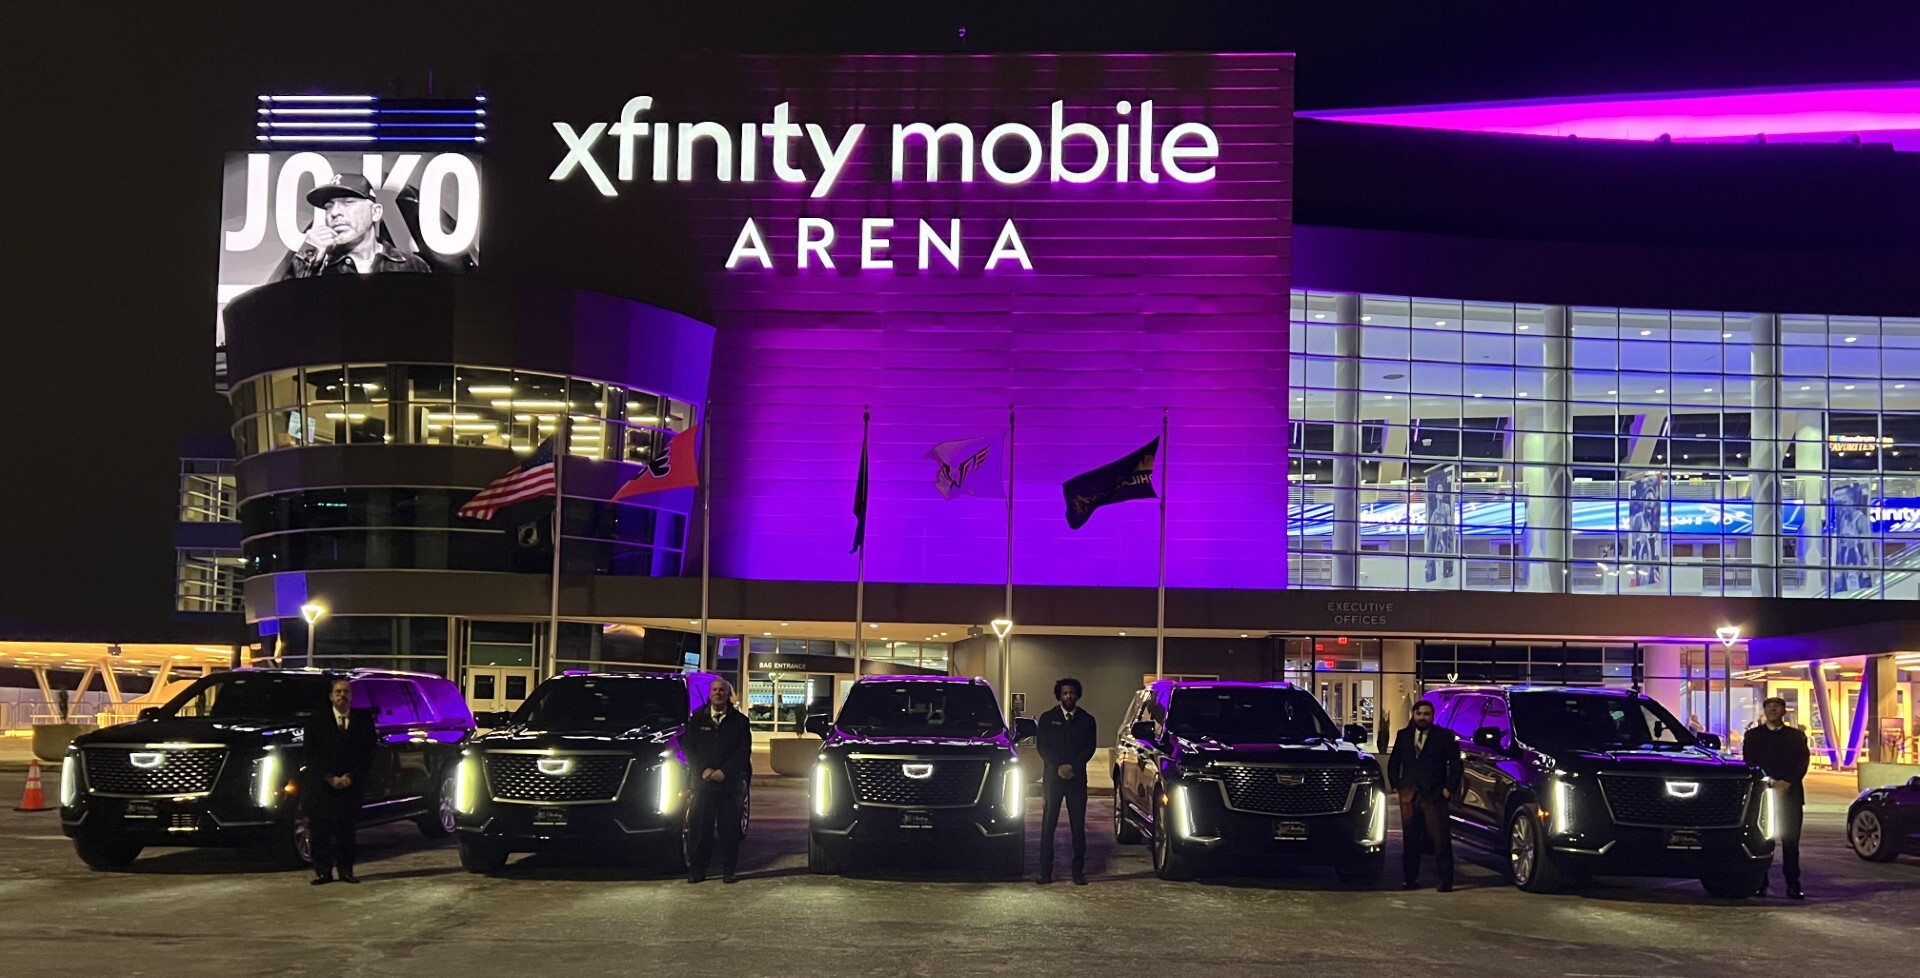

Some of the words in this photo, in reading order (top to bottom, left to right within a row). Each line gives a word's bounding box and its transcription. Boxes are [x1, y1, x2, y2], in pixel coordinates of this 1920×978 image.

[550, 96, 867, 198] xfinity
[891, 99, 1220, 184] mobile
[225, 152, 333, 253] JO
[724, 217, 1034, 270] ARENA
[1327, 602, 1394, 612] EXECUTIVE
[1334, 615, 1387, 625] OFFICES
[759, 661, 772, 669] BAG
